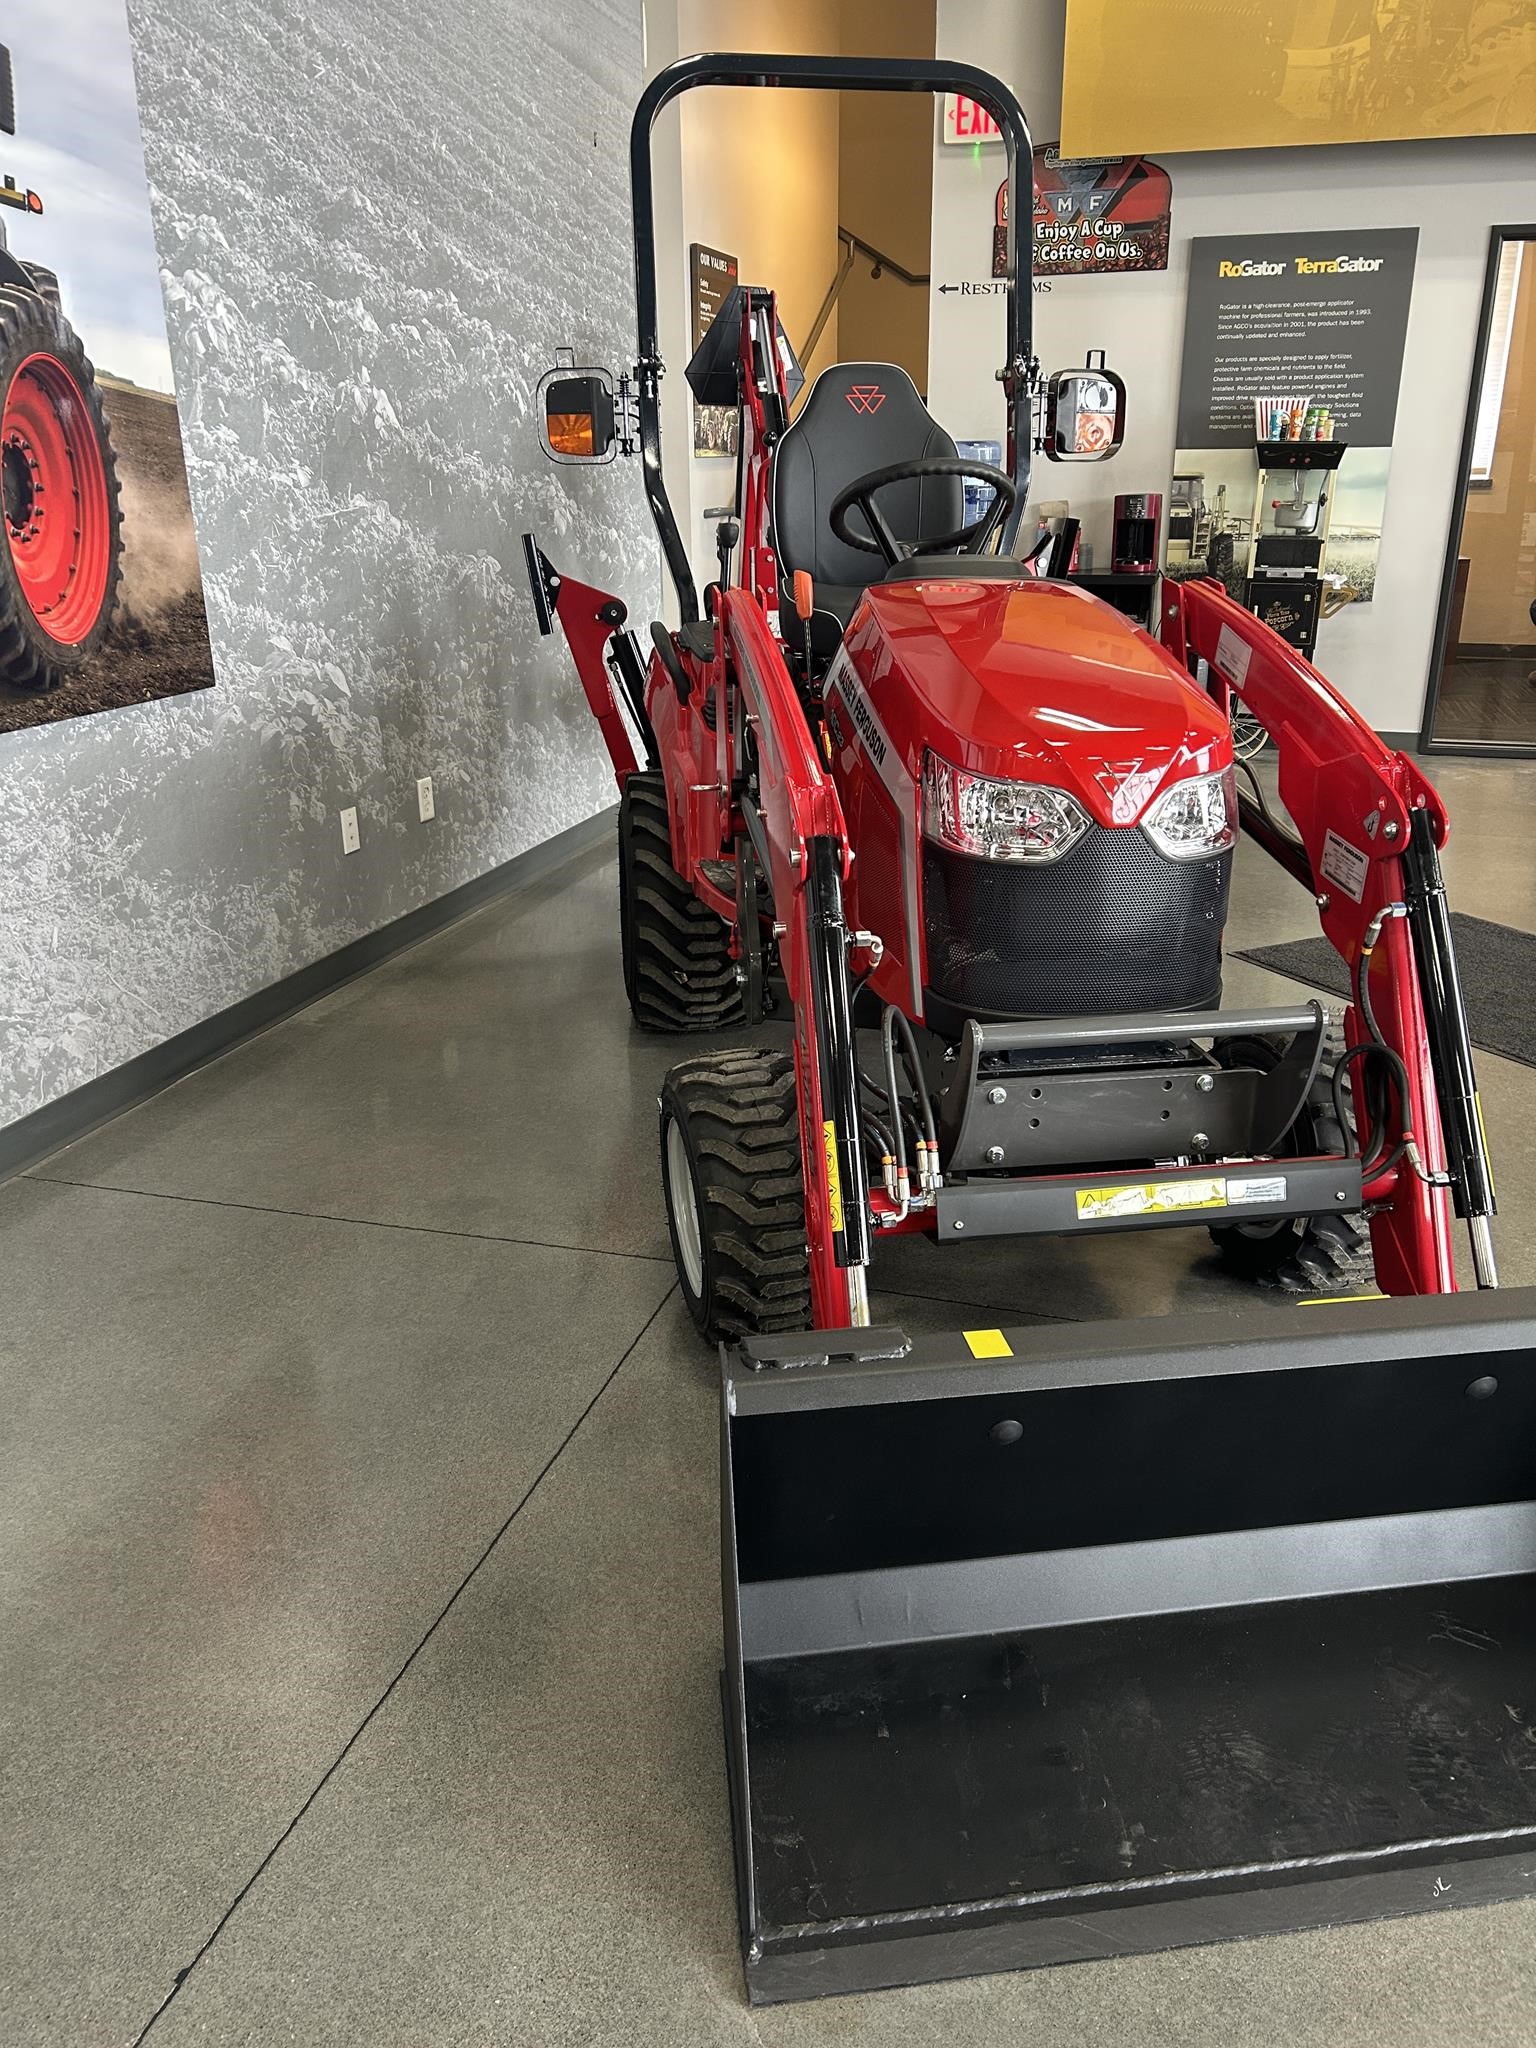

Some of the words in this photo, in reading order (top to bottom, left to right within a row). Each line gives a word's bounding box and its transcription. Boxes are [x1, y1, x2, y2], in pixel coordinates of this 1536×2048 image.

[956, 95, 999, 135] EXI
[1058, 197, 1072, 212] M
[1090, 196, 1103, 210] F
[1036, 221, 1078, 243] Enjoy
[1080, 220, 1092, 237] A
[1094, 218, 1124, 240] Cup
[700, 252, 711, 267] OUR
[710, 256, 728, 273] VALUES
[1040, 246, 1091, 262] Coffee
[1095, 244, 1116, 259] On
[1119, 242, 1142, 258] Us.
[1218, 260, 1287, 278] RoGator
[1294, 256, 1384, 275] TerraGator
[838, 662, 858, 708] MASSEY
[854, 696, 886, 767] FERGUSON
